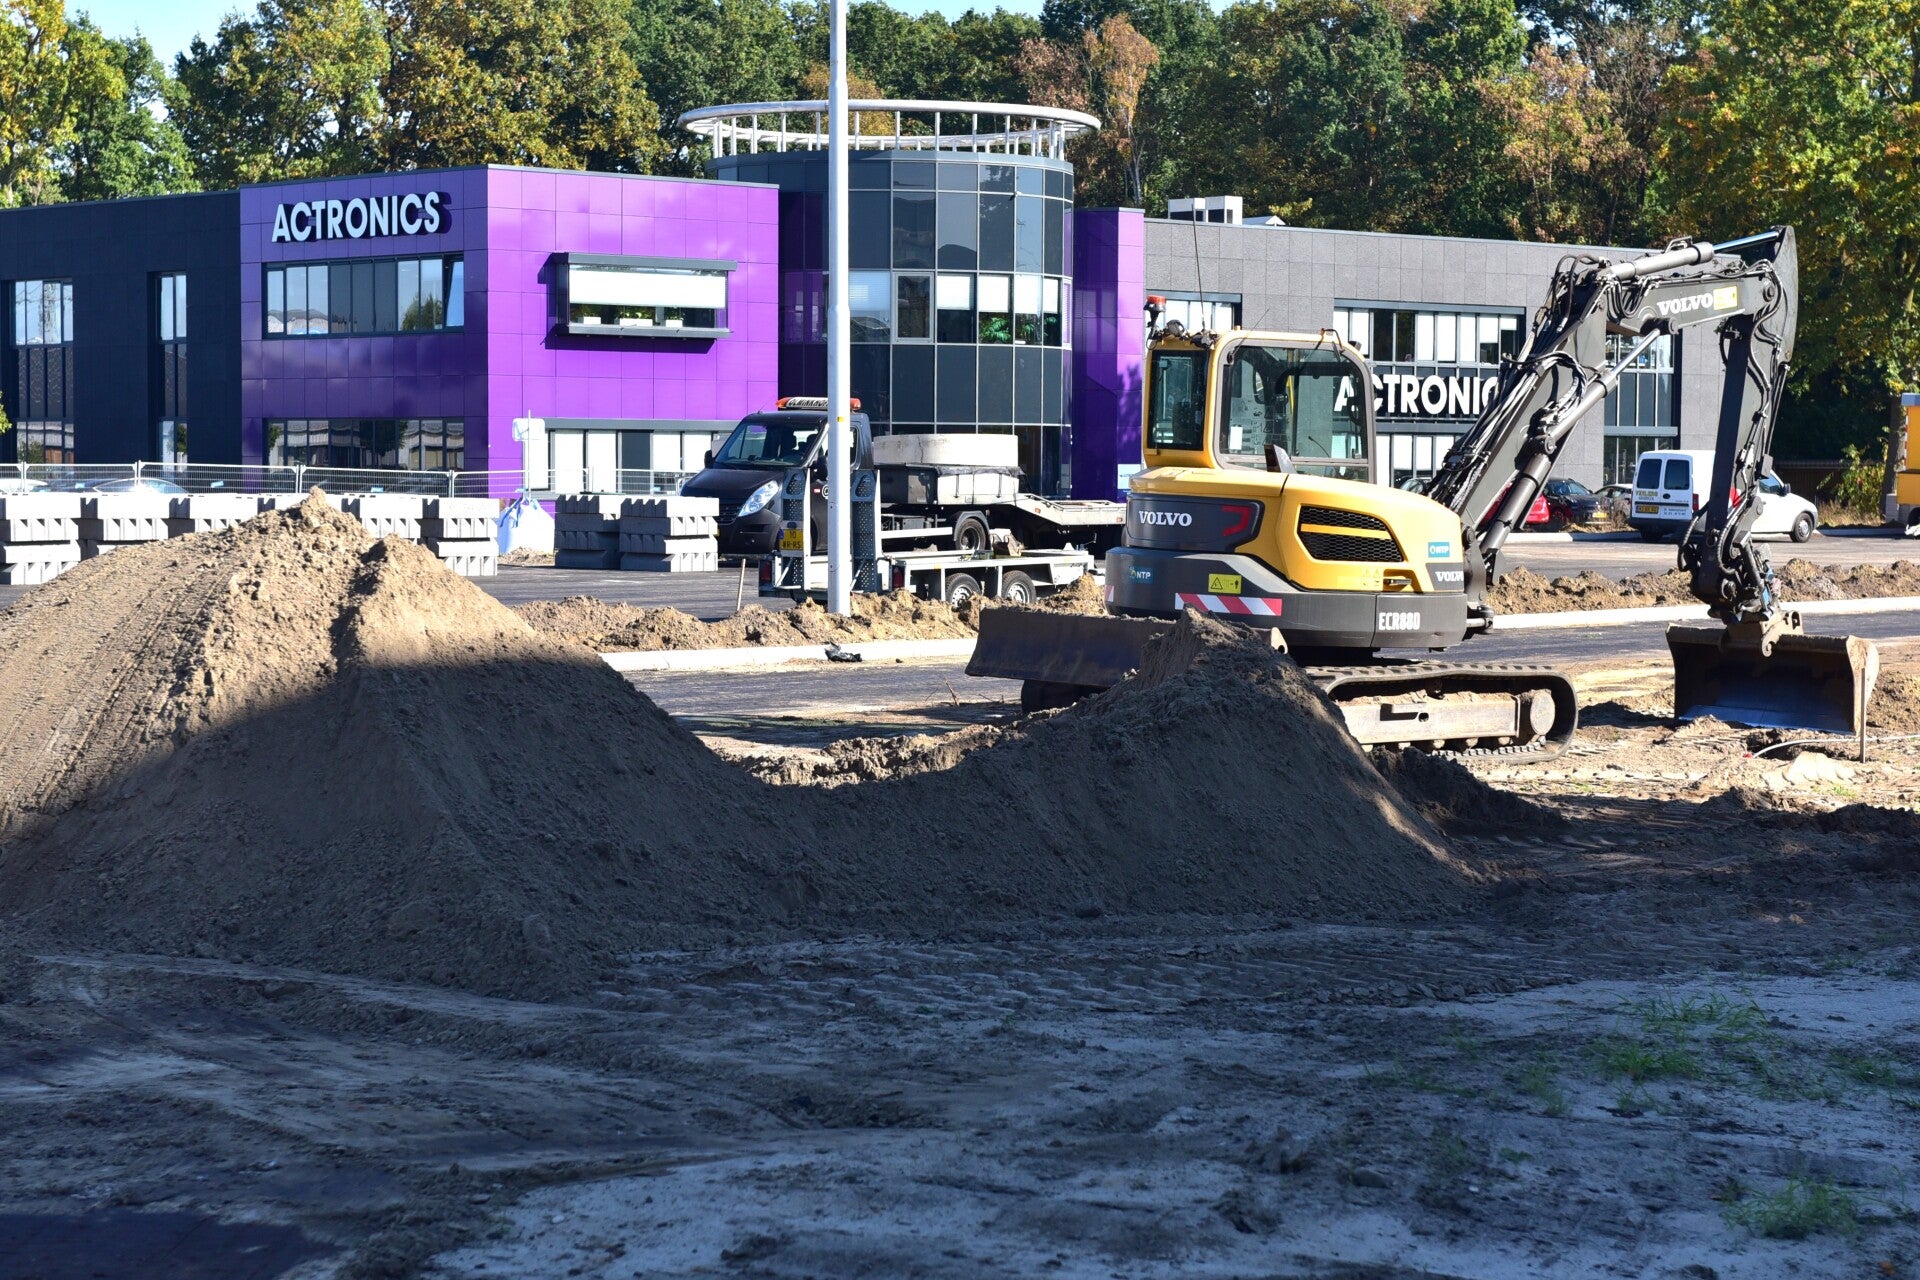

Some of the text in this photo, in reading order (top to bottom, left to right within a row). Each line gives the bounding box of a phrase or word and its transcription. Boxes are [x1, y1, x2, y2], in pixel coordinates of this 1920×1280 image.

[272, 191, 440, 243] ACTRONICS
[1656, 292, 1713, 316] VOLVO
[1333, 373, 1499, 415] ACTRONIC
[1138, 510, 1192, 527] VOLVO
[1136, 571, 1151, 580] NTP
[1378, 611, 1421, 631] ECR88D
